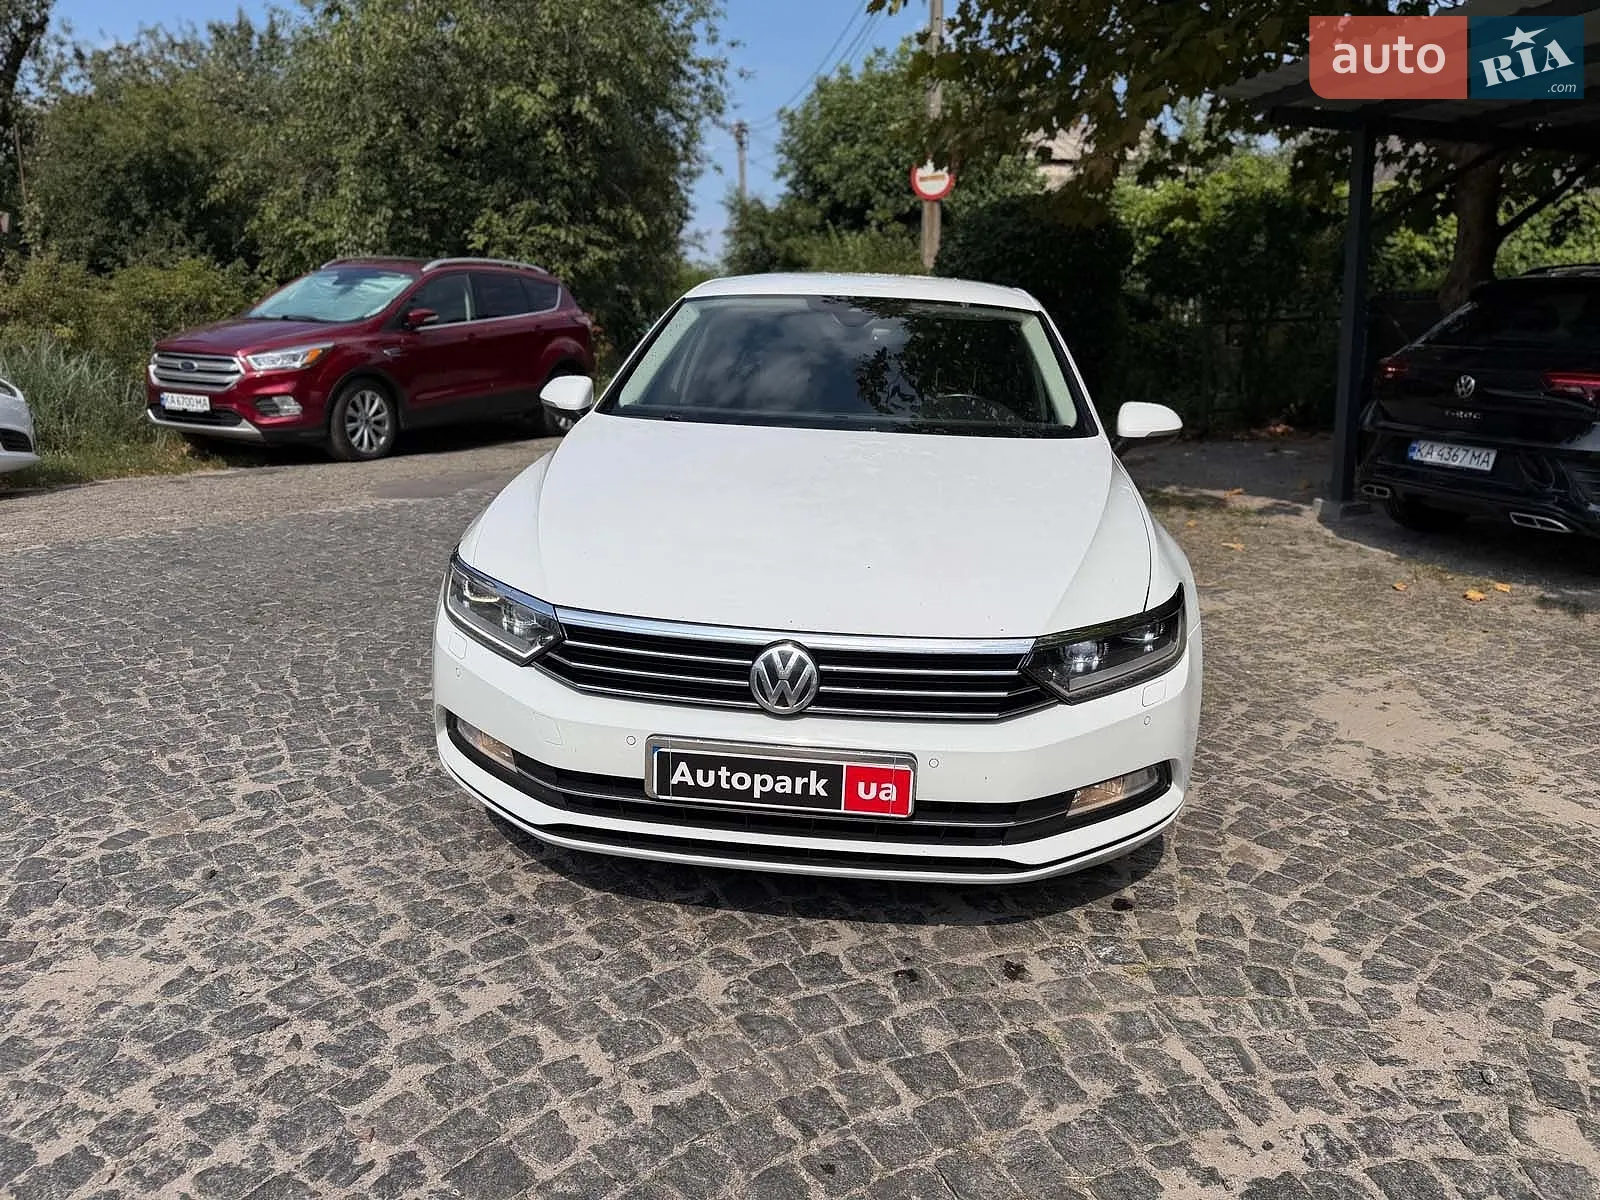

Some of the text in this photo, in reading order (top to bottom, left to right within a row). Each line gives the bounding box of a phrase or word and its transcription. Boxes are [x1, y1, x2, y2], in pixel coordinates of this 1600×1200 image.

[1416, 441, 1491, 467] KA 4367 MA
[671, 761, 897, 802] Autopark ua
